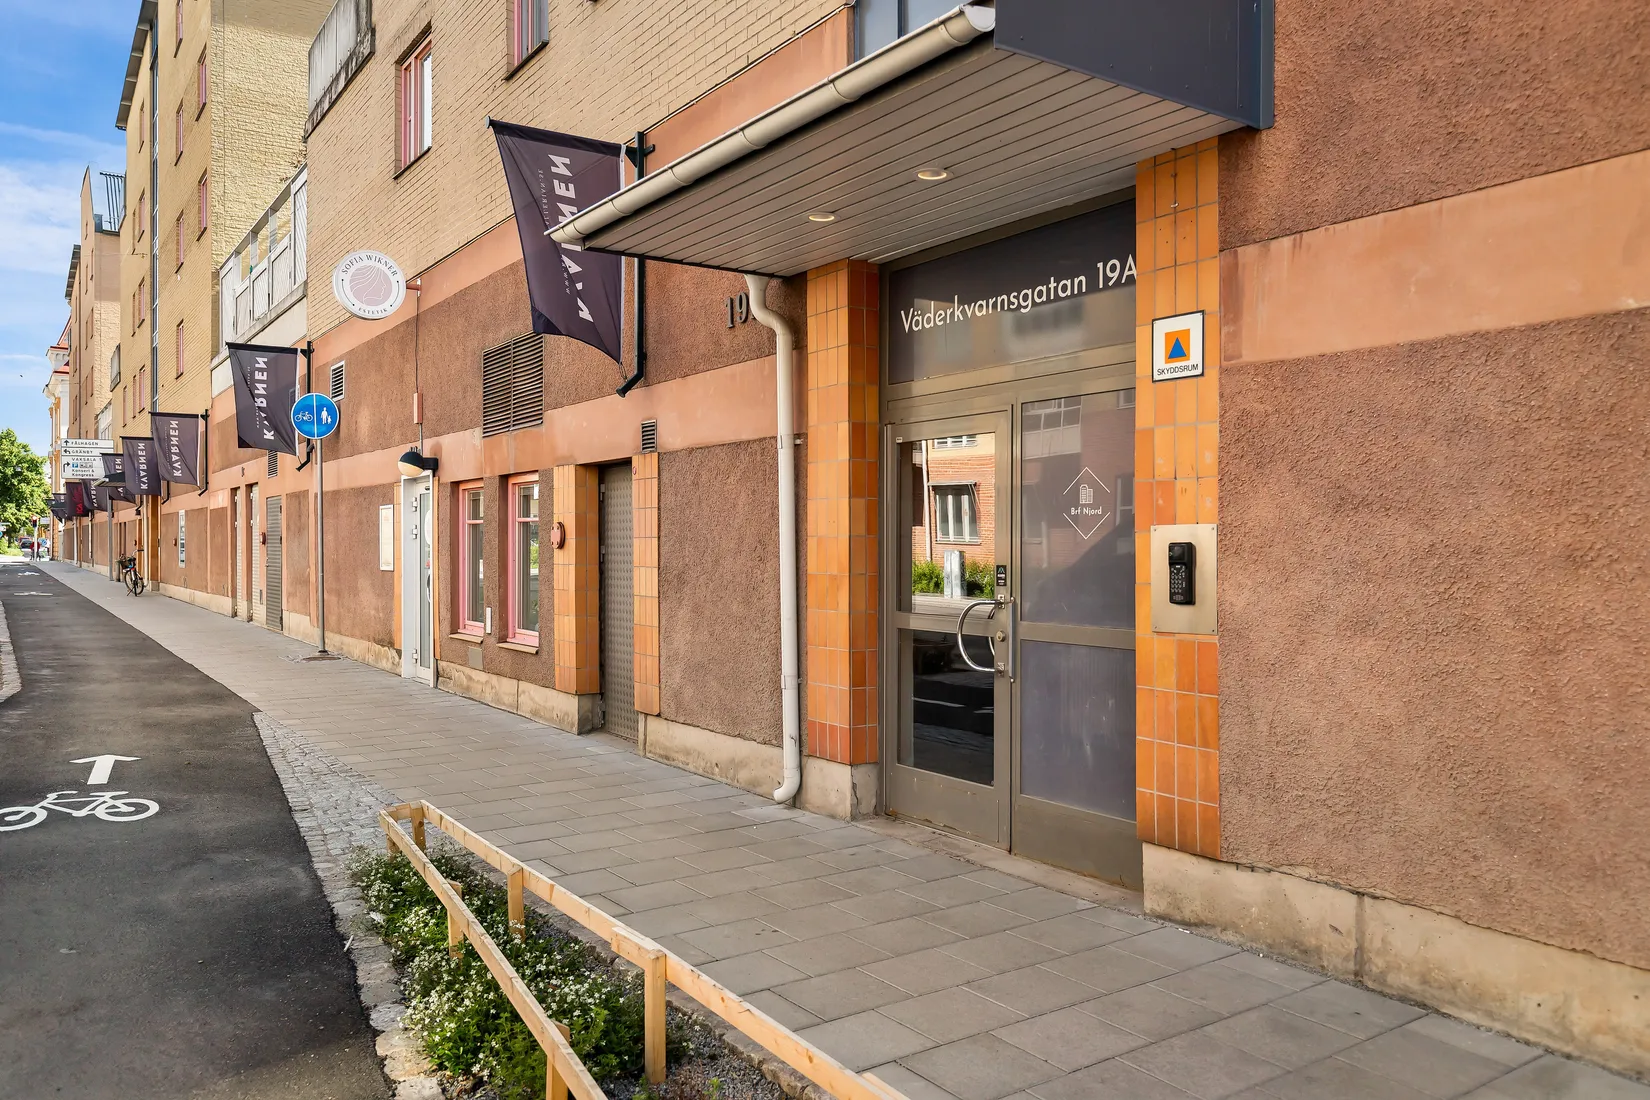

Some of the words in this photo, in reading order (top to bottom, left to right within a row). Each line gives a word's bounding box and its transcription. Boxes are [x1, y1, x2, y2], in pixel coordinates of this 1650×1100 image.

[341, 254, 364, 275] SOFIA
[365, 254, 398, 277] WIKNER
[900, 274, 1086, 333] Väderkvarnsgatan
[1096, 253, 1137, 289] 19A
[358, 307, 388, 315] ESTETIK
[725, 291, 751, 328] 19
[1156, 363, 1199, 376] SKYDDSRUM
[1070, 506, 1082, 515] Brf
[1083, 505, 1102, 516] Njord
